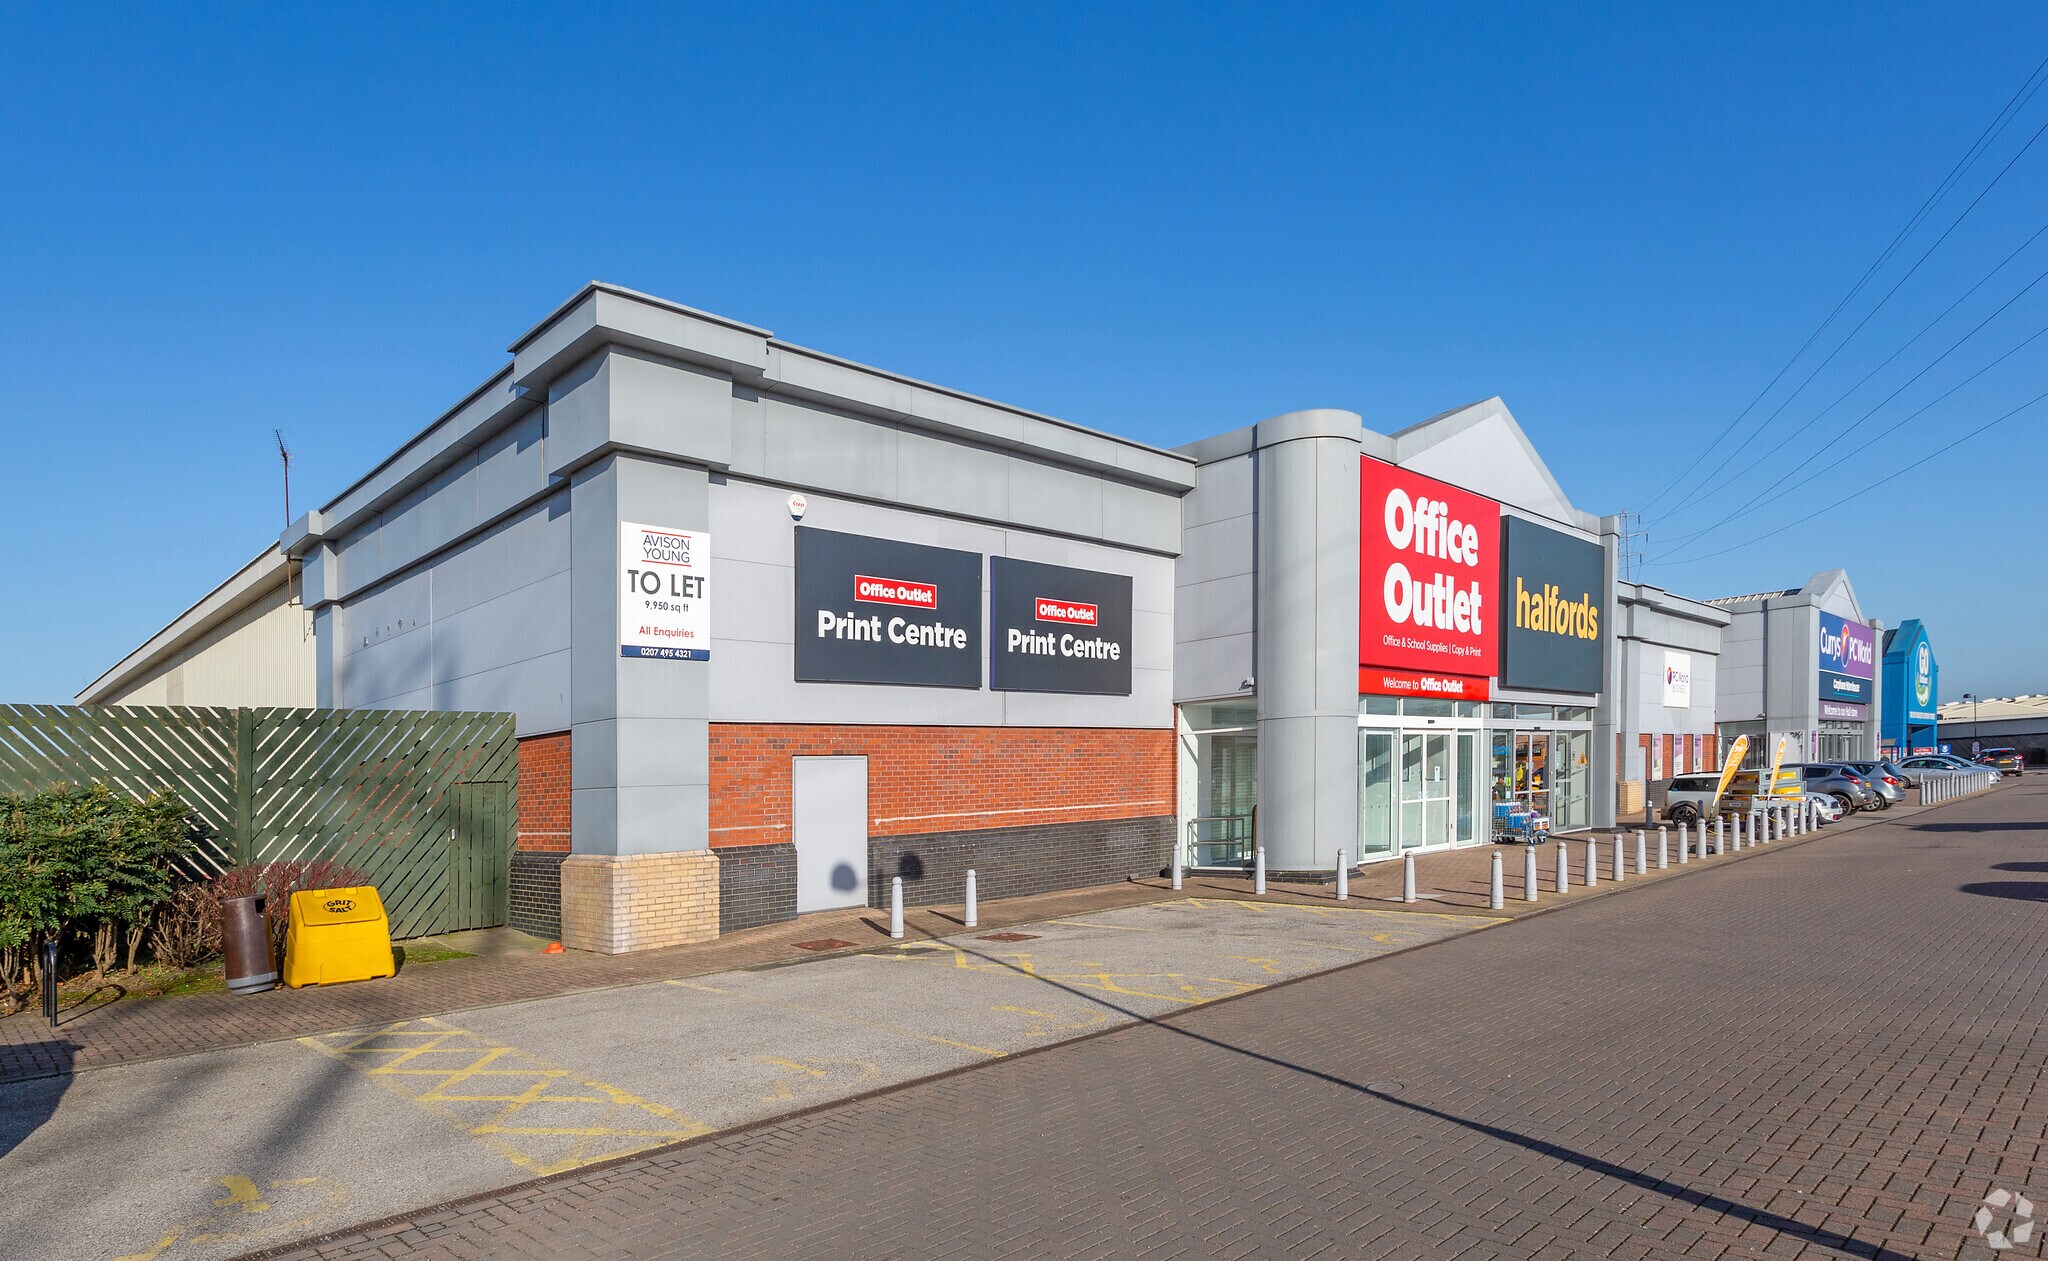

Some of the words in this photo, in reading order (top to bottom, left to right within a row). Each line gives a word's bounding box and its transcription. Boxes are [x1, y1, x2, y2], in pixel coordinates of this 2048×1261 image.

[1384, 488, 1479, 567] Office
[643, 534, 690, 551] AVISON
[643, 547, 690, 563] YOUNG
[628, 569, 661, 595] TO
[671, 573, 705, 599] LET
[860, 582, 896, 599] Office
[897, 586, 932, 603] Outlet
[645, 600, 669, 610] 9,950
[670, 604, 681, 614] sq
[683, 603, 689, 612] ft
[1384, 562, 1482, 636] Outlet
[1516, 576, 1598, 641] halfords
[1039, 603, 1067, 618] Office
[1067, 607, 1094, 621] Outlet
[639, 626, 651, 635] All
[653, 626, 695, 638] Enquiries
[818, 610, 882, 642] Print
[887, 616, 967, 649] Centre
[641, 648, 659, 656] 0207
[660, 648, 674, 658] 495
[675, 649, 691, 658] 4321
[1008, 628, 1056, 656] Print
[1060, 633, 1121, 661] Centre
[1383, 634, 1401, 647] Office
[1401, 637, 1406, 648] &
[1407, 638, 1426, 650] School
[1426, 640, 1449, 654] Supplies
[1451, 644, 1465, 657] Copy
[1465, 646, 1470, 656] &
[1470, 647, 1481, 657] Print
[1820, 626, 1841, 662] Currys
[1383, 676, 1412, 690] Welcome
[1412, 679, 1419, 690] to
[1421, 677, 1442, 692] Office
[1442, 679, 1464, 693] Outlet
[329, 905, 352, 913] SALT
